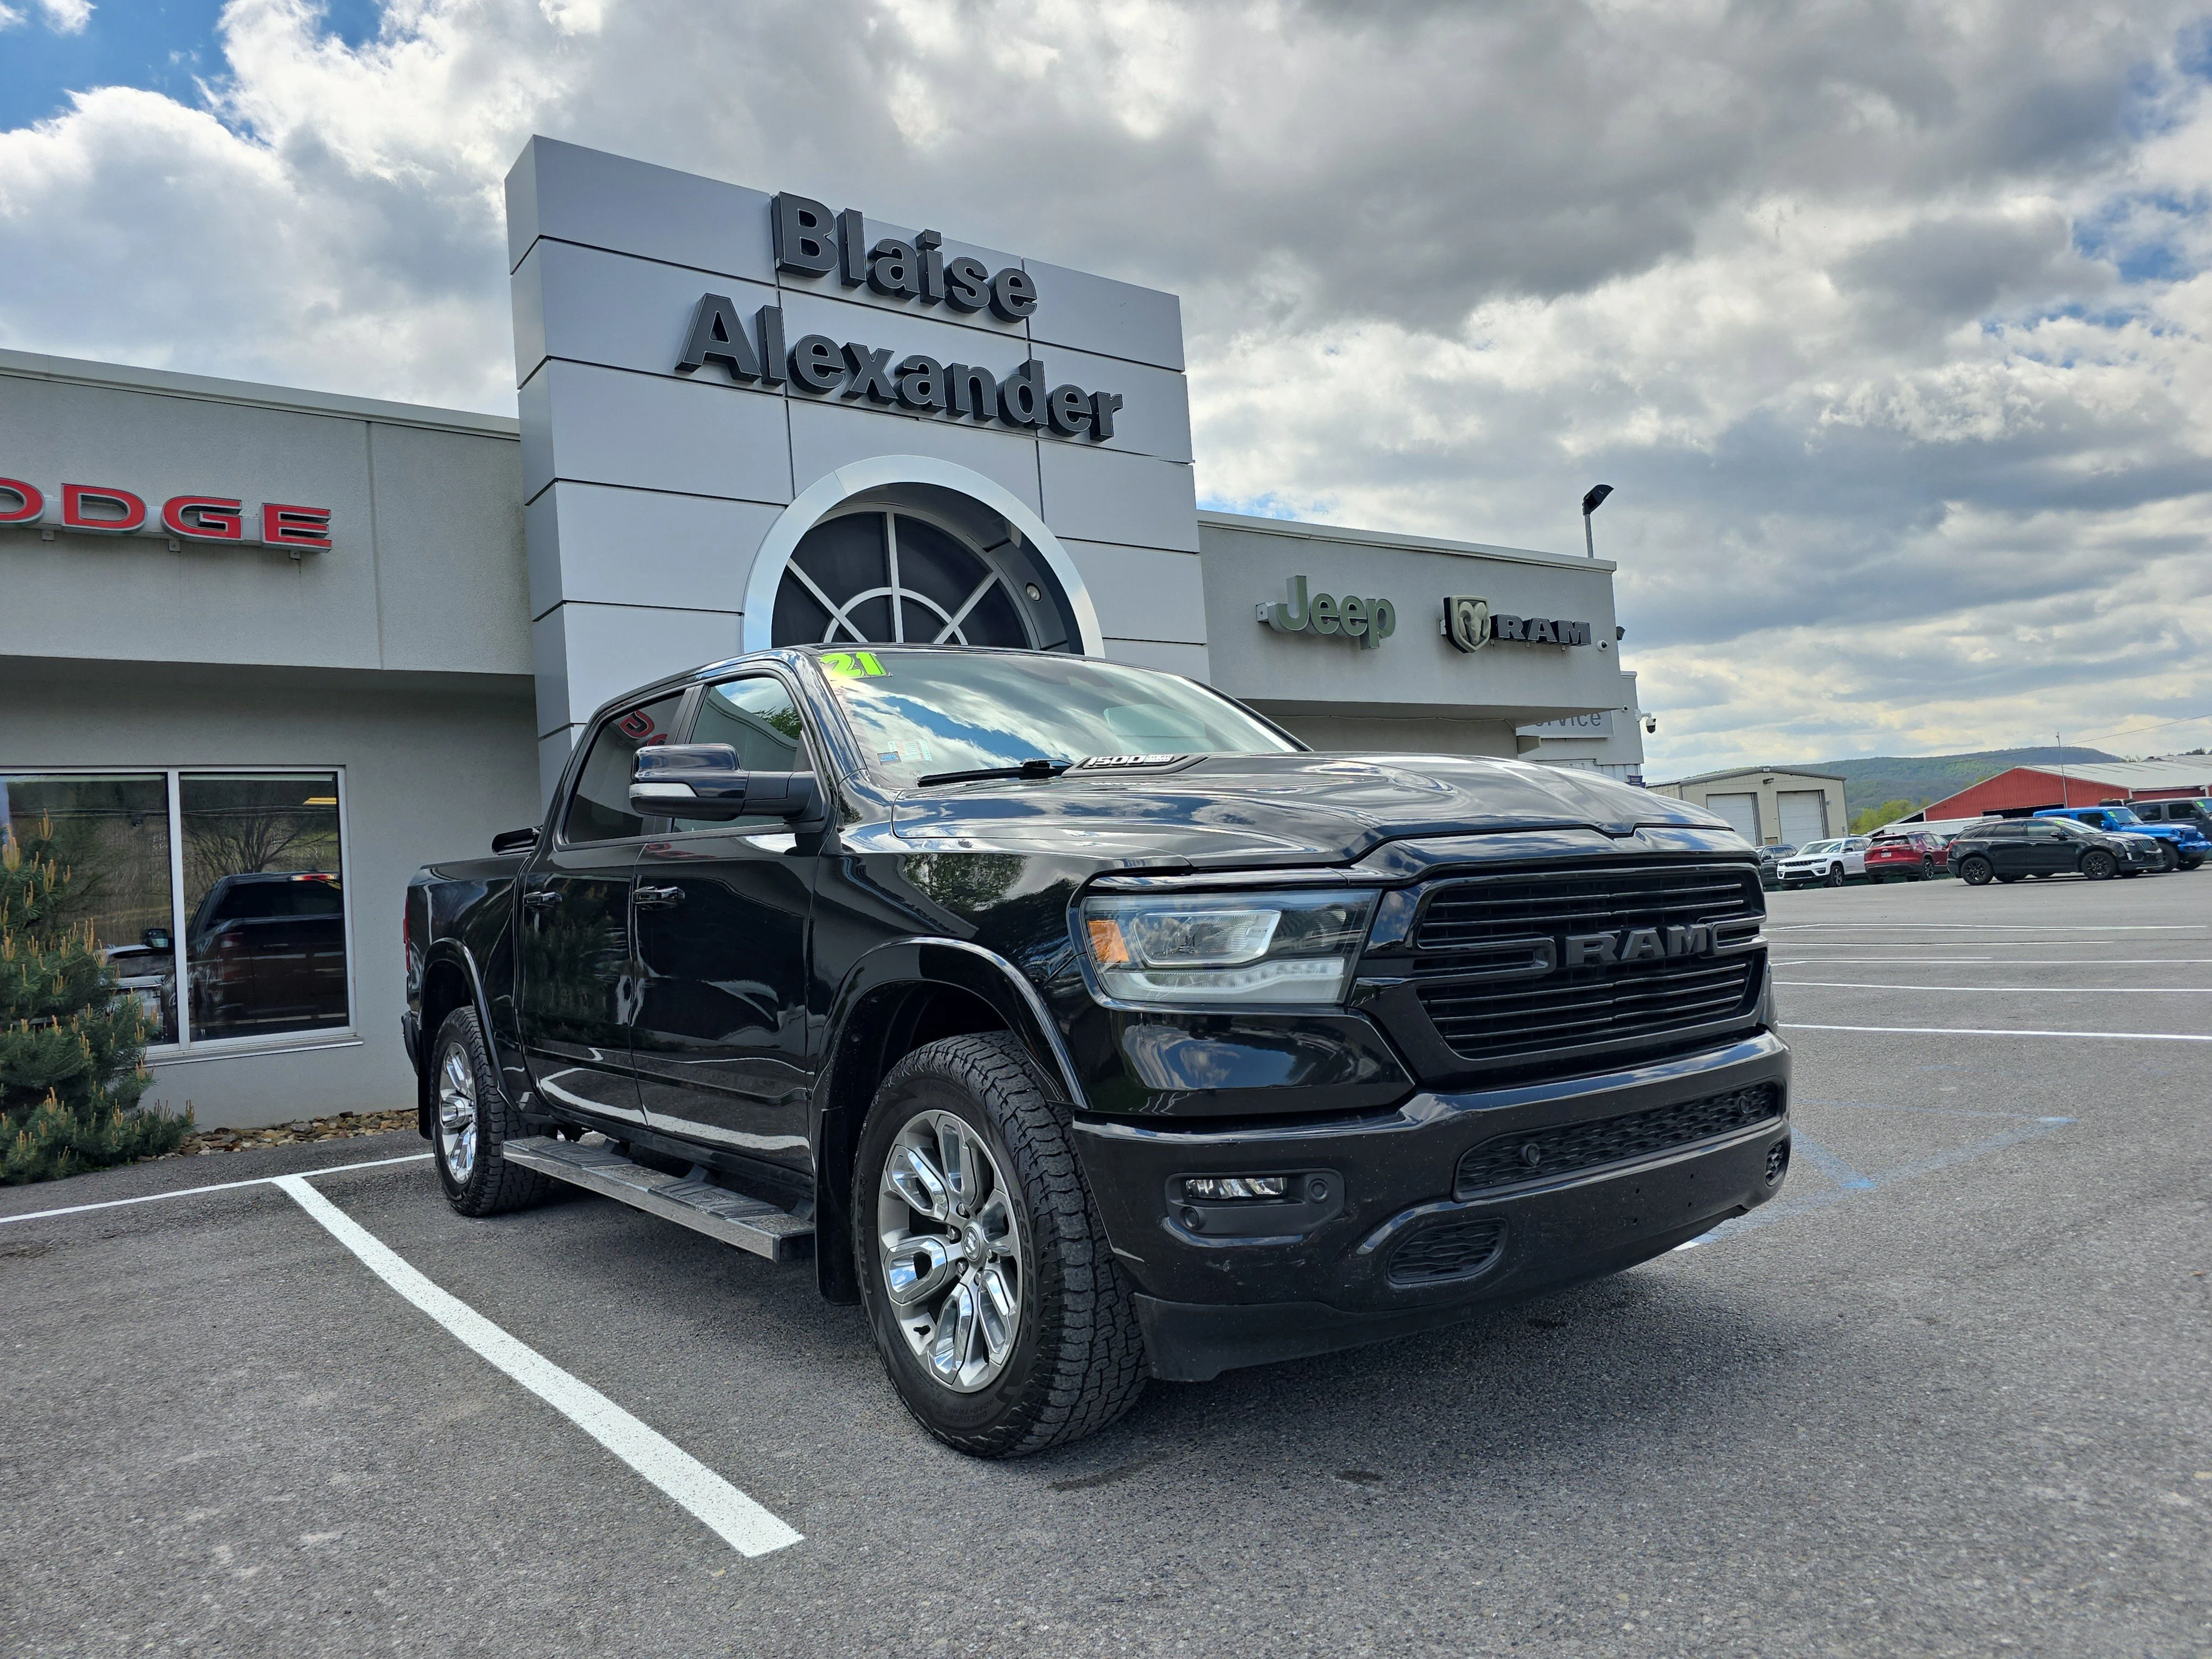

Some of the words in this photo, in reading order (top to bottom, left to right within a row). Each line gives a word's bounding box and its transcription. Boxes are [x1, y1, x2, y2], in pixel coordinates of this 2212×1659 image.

[771, 191, 1037, 323] Blaise
[674, 293, 1123, 442] Alexander
[0, 478, 332, 554] ODGE
[1268, 575, 1396, 650] Jeep
[1490, 614, 1591, 647] RAM
[819, 652, 886, 677] 21
[1533, 712, 1602, 728] vice
[1087, 755, 1147, 767] 1500
[1565, 923, 1707, 966] RAM
[1014, 1198, 1033, 1342] COOPER
